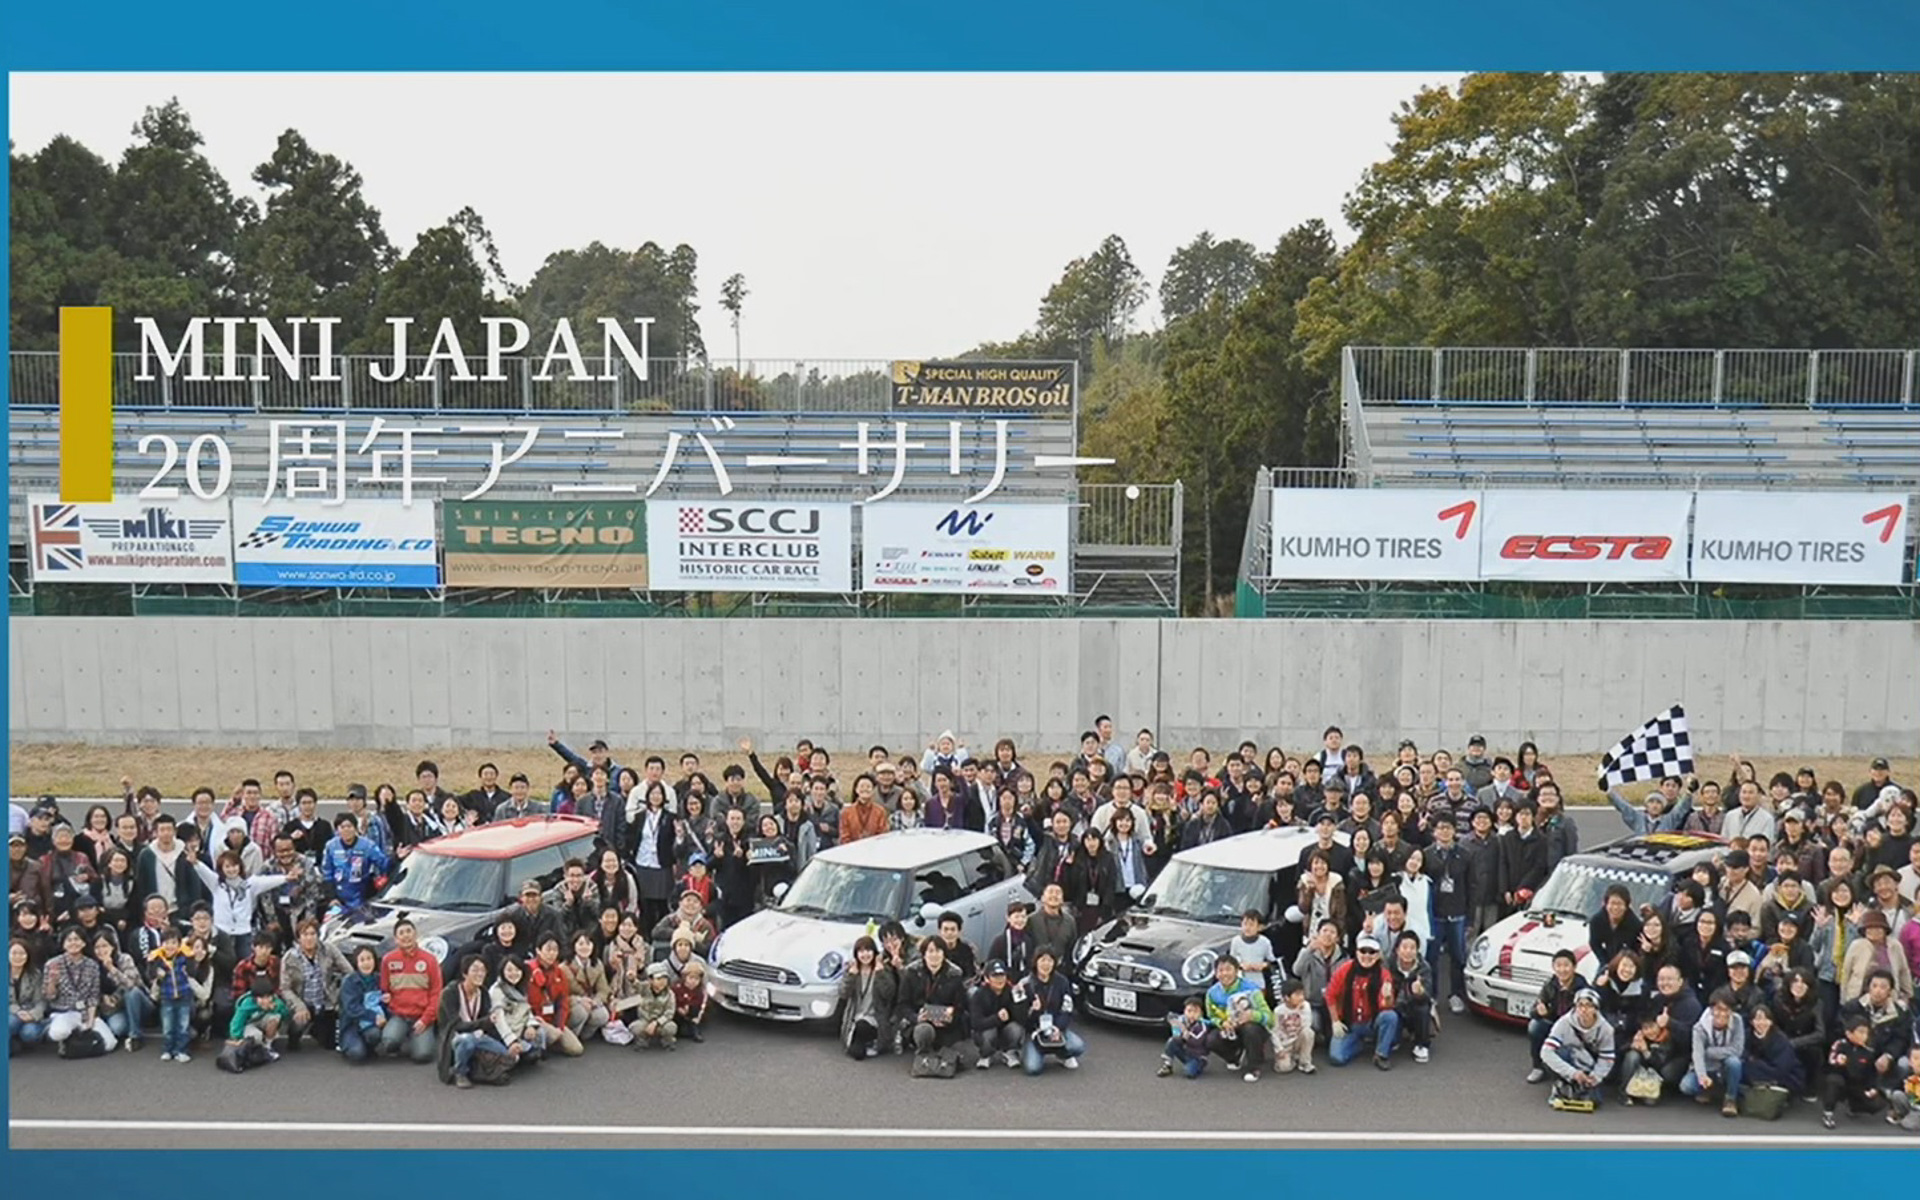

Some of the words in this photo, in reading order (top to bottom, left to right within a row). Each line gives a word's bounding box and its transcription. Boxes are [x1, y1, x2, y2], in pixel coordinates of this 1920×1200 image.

[925, 369, 973, 380] SPECIAL
[976, 369, 1007, 381] HIGH
[1009, 368, 1060, 381] QUALITY
[255, 515, 361, 533] SANWA
[706, 507, 820, 534] SCCJ
[456, 525, 635, 545] TECNO
[679, 541, 820, 558] INTERCLUB
[1013, 551, 1055, 560] WARM
[1281, 536, 1371, 558] KUMHO
[1376, 538, 1443, 559] TIRES
[1700, 539, 1793, 561] KUMHO
[1798, 541, 1866, 563] TIRES
[87, 554, 226, 568] www.mikipreparation.com
[680, 563, 748, 574] HISTORIC
[752, 564, 781, 575] CAR
[783, 565, 819, 576] RACE
